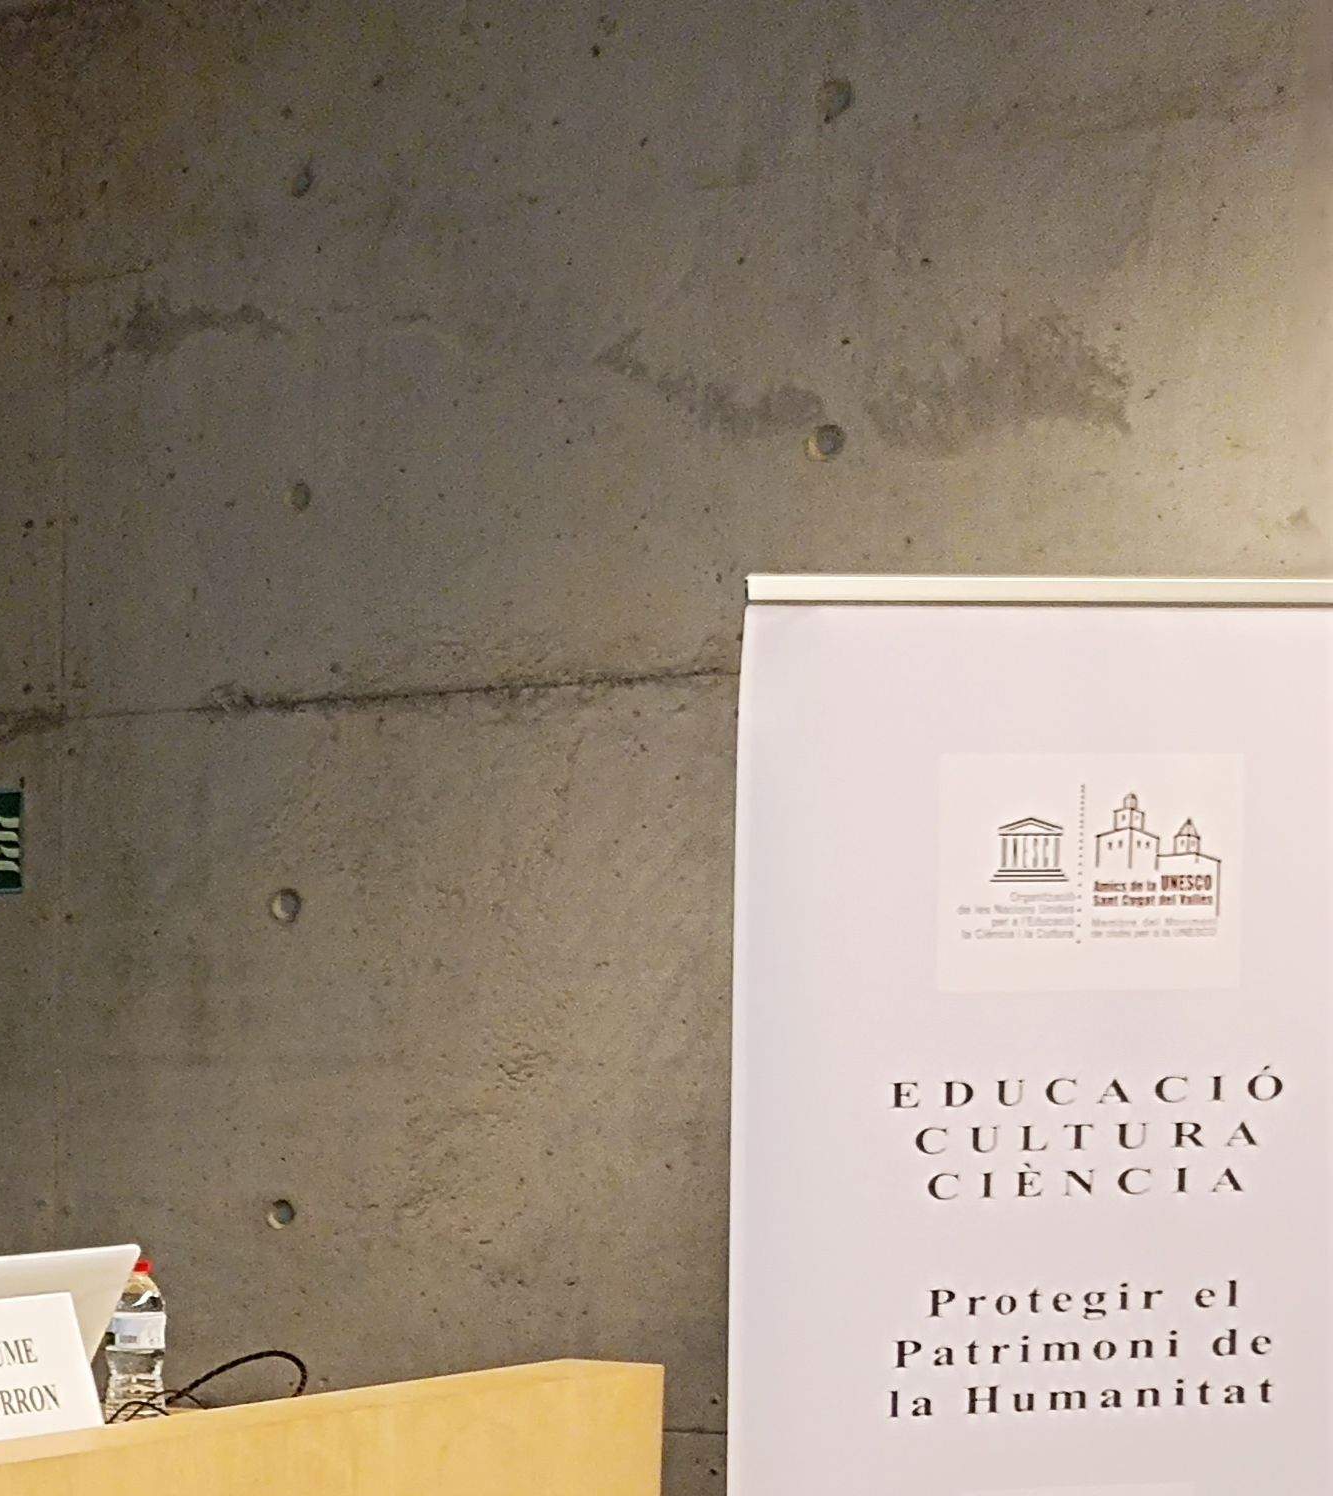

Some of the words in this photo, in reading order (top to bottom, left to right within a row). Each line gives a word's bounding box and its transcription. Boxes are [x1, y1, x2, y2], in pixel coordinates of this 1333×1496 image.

[1161, 874, 1213, 891] UNESCO
[889, 1065, 1285, 1110] EDUCACIÓ
[914, 1120, 1260, 1155] CULTURA
[927, 1163, 1245, 1200] CIÈNCIA
[929, 1282, 1164, 1321] Protegir
[1194, 1279, 1241, 1309] el
[894, 1329, 1181, 1369] Patrimoni
[1212, 1328, 1274, 1357] de
[888, 1389, 934, 1419] la
[966, 1376, 1276, 1416] Humanitat
